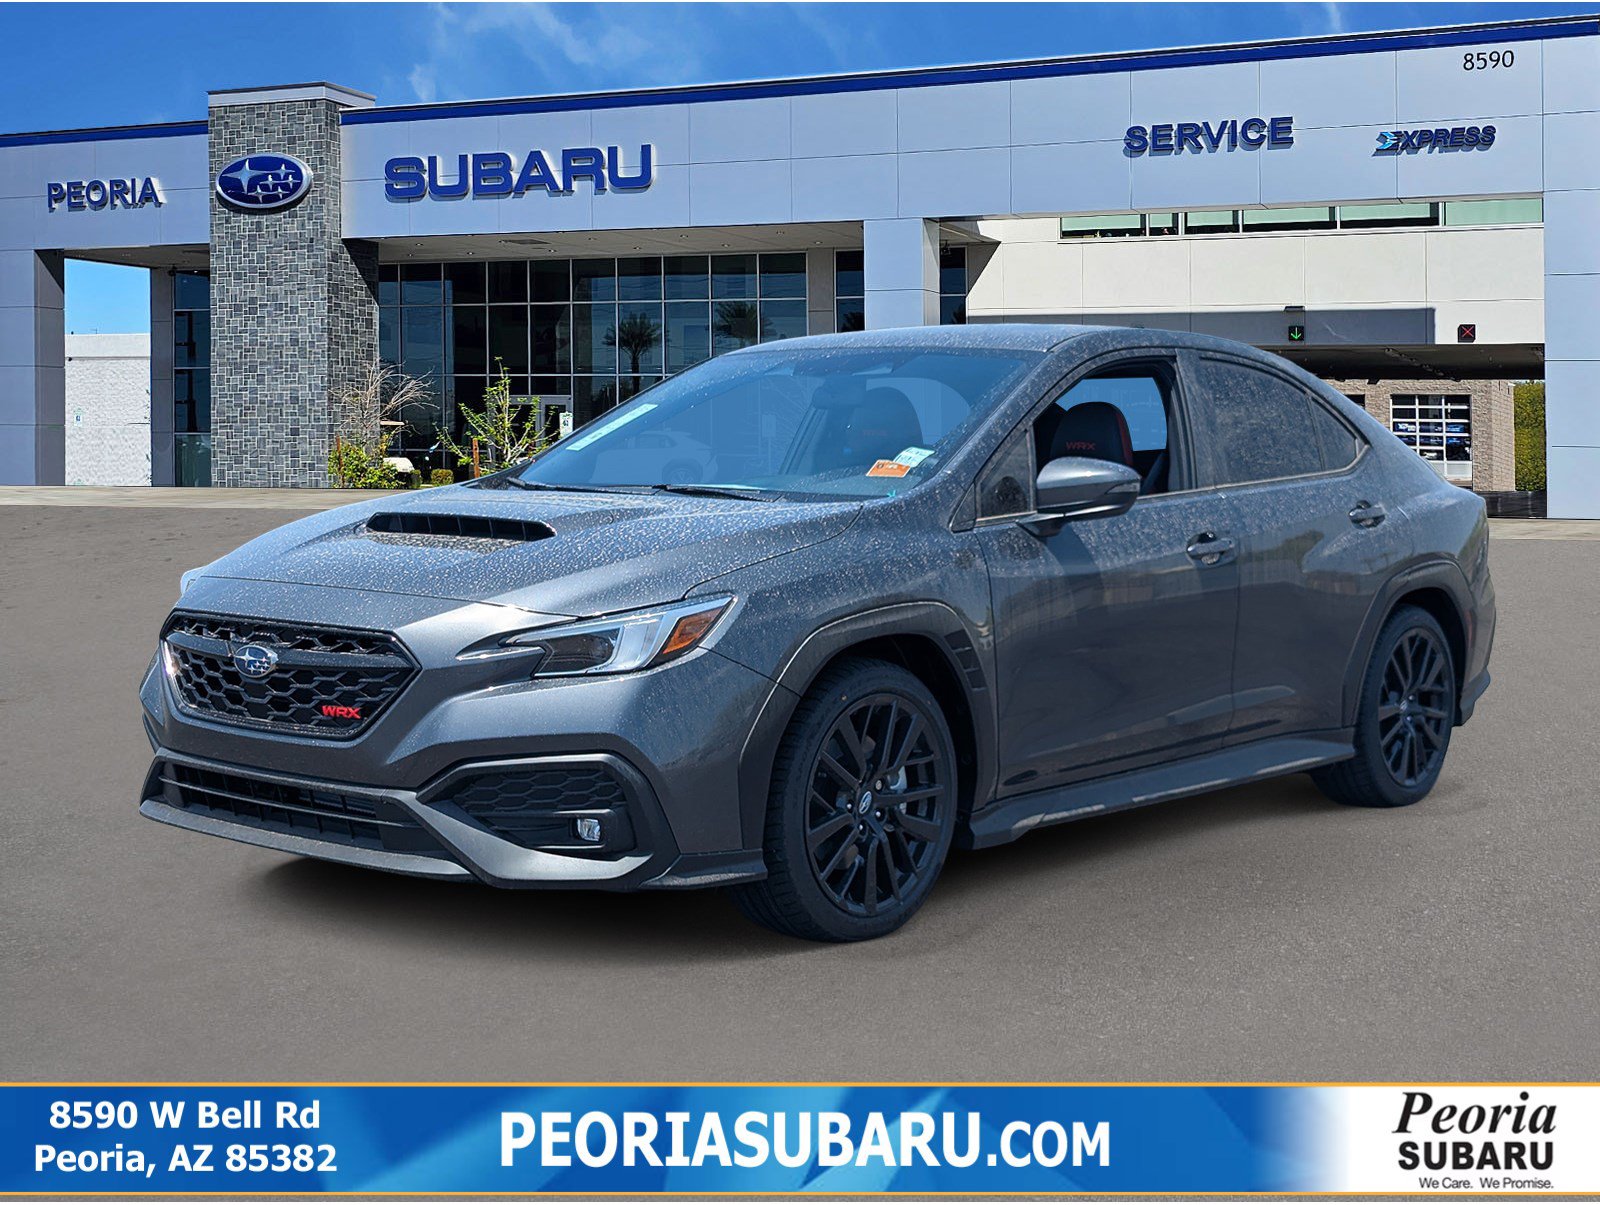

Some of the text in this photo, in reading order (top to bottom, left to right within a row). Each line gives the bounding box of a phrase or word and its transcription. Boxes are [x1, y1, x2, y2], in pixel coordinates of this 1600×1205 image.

[1463, 49, 1515, 72] 8590
[1124, 116, 1294, 156] SERVICE
[1375, 125, 1497, 151] EXPRESS
[384, 144, 653, 201] SUBARU
[48, 176, 163, 212] PEORIA
[321, 705, 362, 719] WRX
